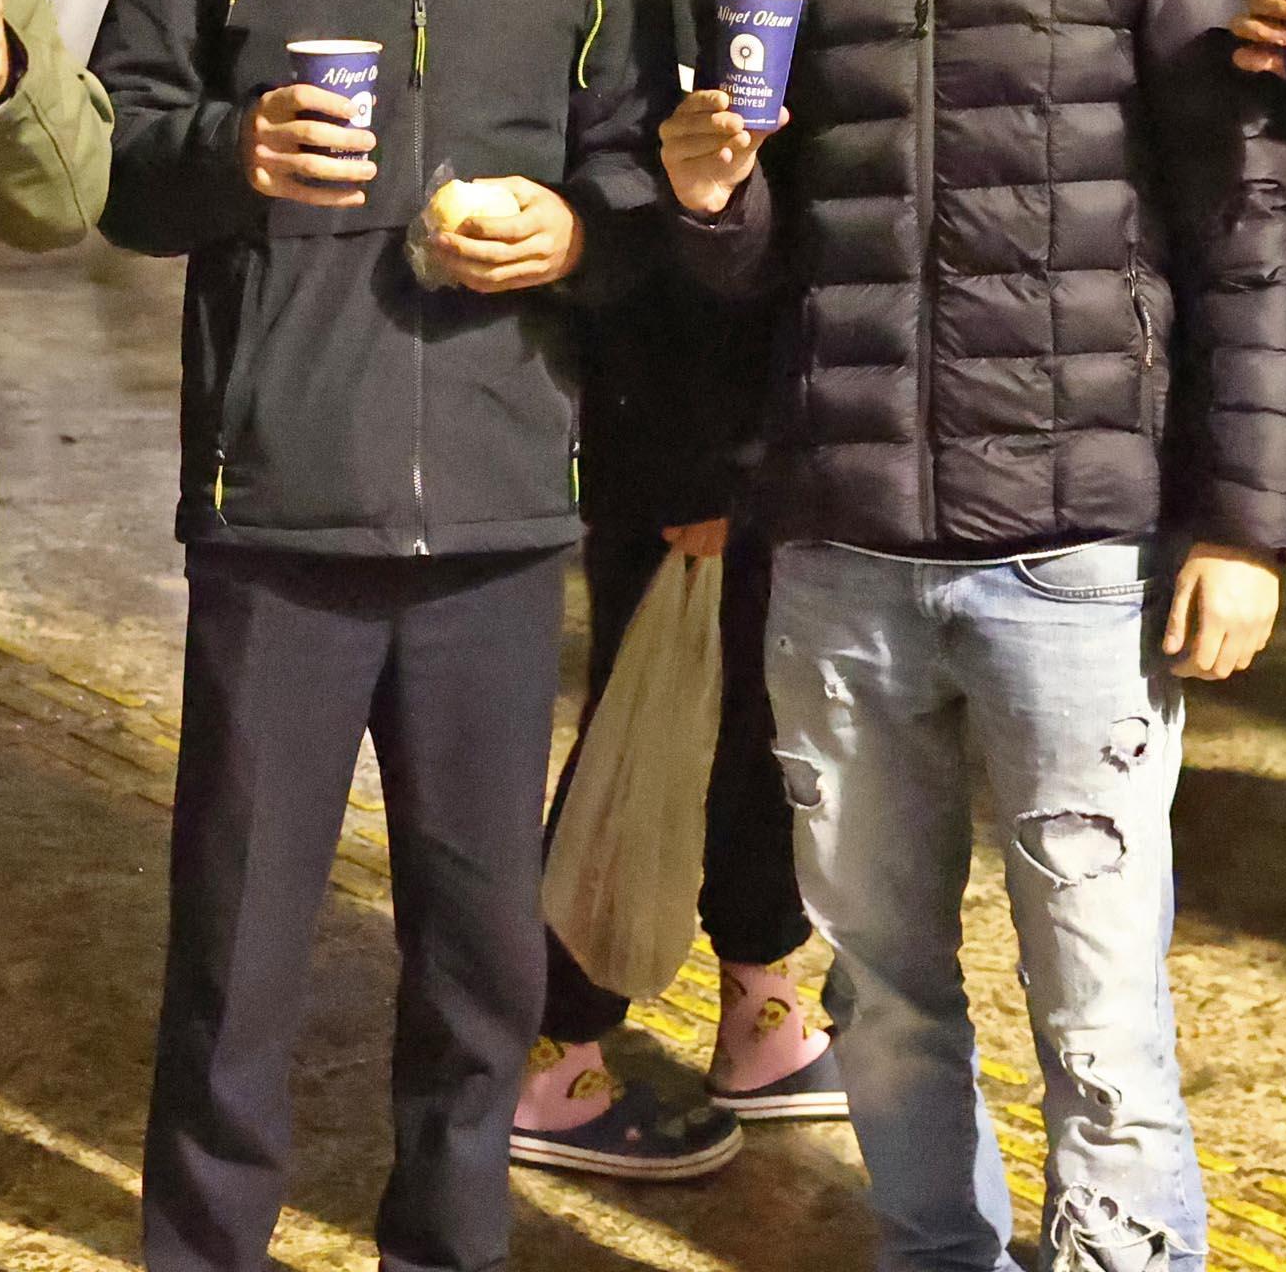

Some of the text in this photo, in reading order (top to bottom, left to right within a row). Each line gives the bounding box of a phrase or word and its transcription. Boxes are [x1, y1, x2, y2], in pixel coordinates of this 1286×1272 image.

[753, 10, 793, 27] Olsun
[321, 67, 368, 89] Afiyet
[726, 73, 765, 85] ANTALYA
[729, 97, 766, 108] LEDİYESİ
